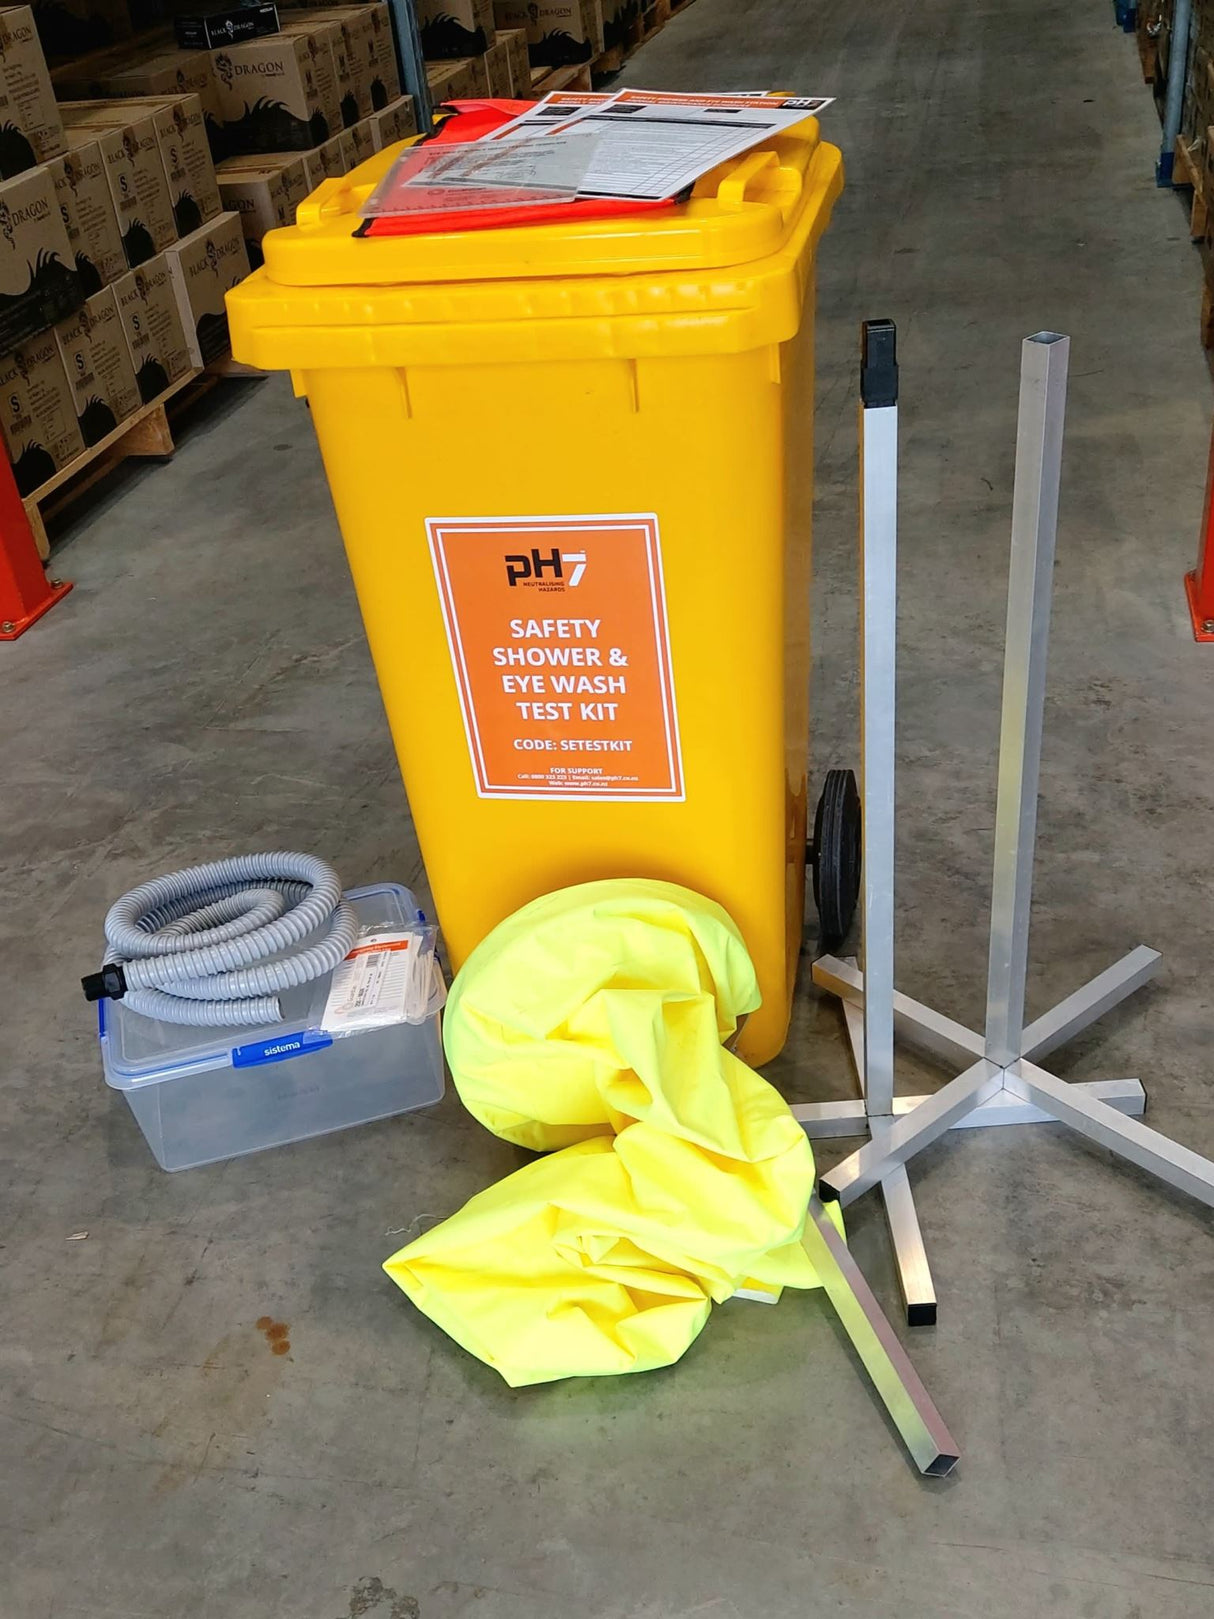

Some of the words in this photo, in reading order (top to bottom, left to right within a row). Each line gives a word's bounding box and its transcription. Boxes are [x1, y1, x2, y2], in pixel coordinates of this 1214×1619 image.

[234, 61, 283, 76] DRAGON
[169, 147, 179, 164] S
[119, 176, 128, 192] S
[12, 196, 50, 227] DRAGON
[60, 205, 70, 223] S
[132, 315, 141, 331] S
[75, 353, 85, 370] S
[10, 395, 21, 413] S
[509, 619, 601, 639] SAFETY
[492, 647, 603, 667] SHOWER
[609, 647, 629, 667] &
[502, 675, 547, 694] EYE
[549, 675, 627, 695] WASH
[515, 702, 573, 721] TEST
[579, 702, 619, 722] KIT
[513, 738, 558, 751] CODE:
[560, 739, 633, 752] SETESTKIT
[568, 767, 603, 775] SUPPORT
[264, 1041, 301, 1057] sistema
